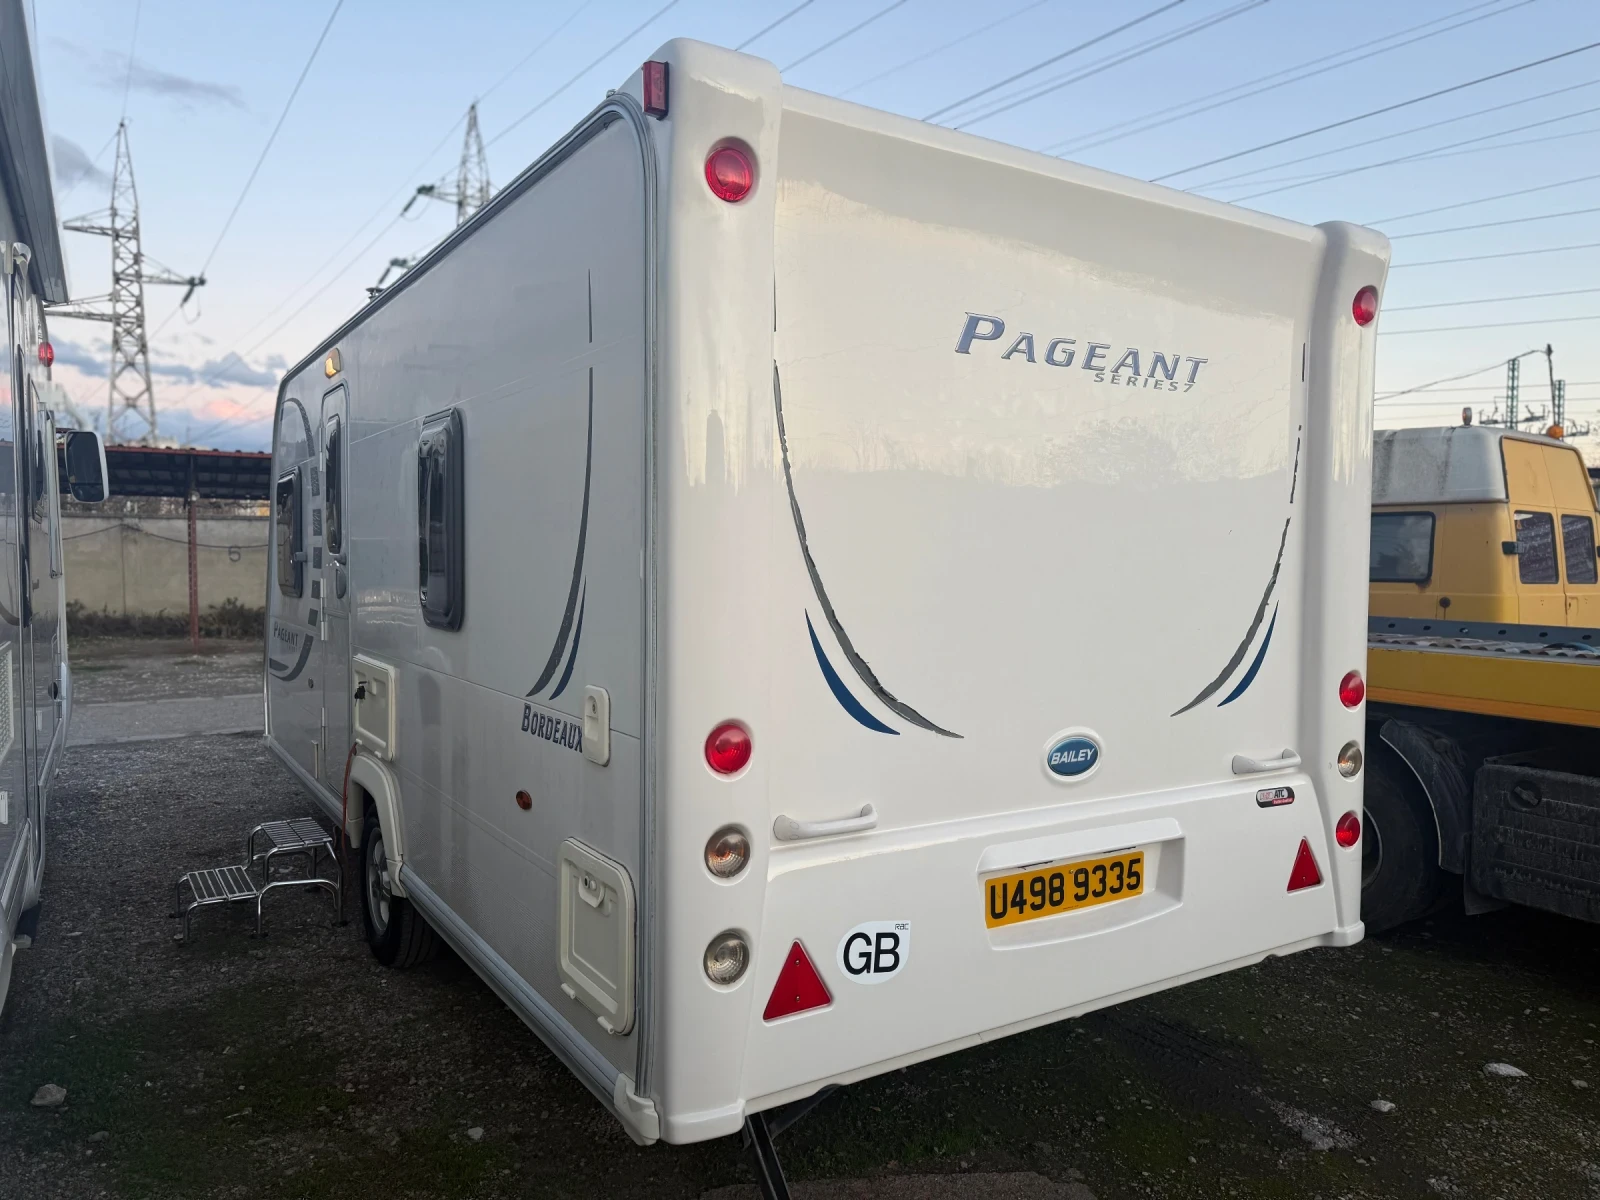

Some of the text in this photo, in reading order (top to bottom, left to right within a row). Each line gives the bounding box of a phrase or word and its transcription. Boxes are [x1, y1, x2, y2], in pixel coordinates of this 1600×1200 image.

[954, 311, 1209, 384] PAGEANT
[521, 702, 583, 754] BORDEAUX
[1050, 748, 1095, 765] BAILEY
[1273, 789, 1286, 799] ATC
[989, 857, 1142, 920] U498 9335
[843, 932, 900, 975] GB
